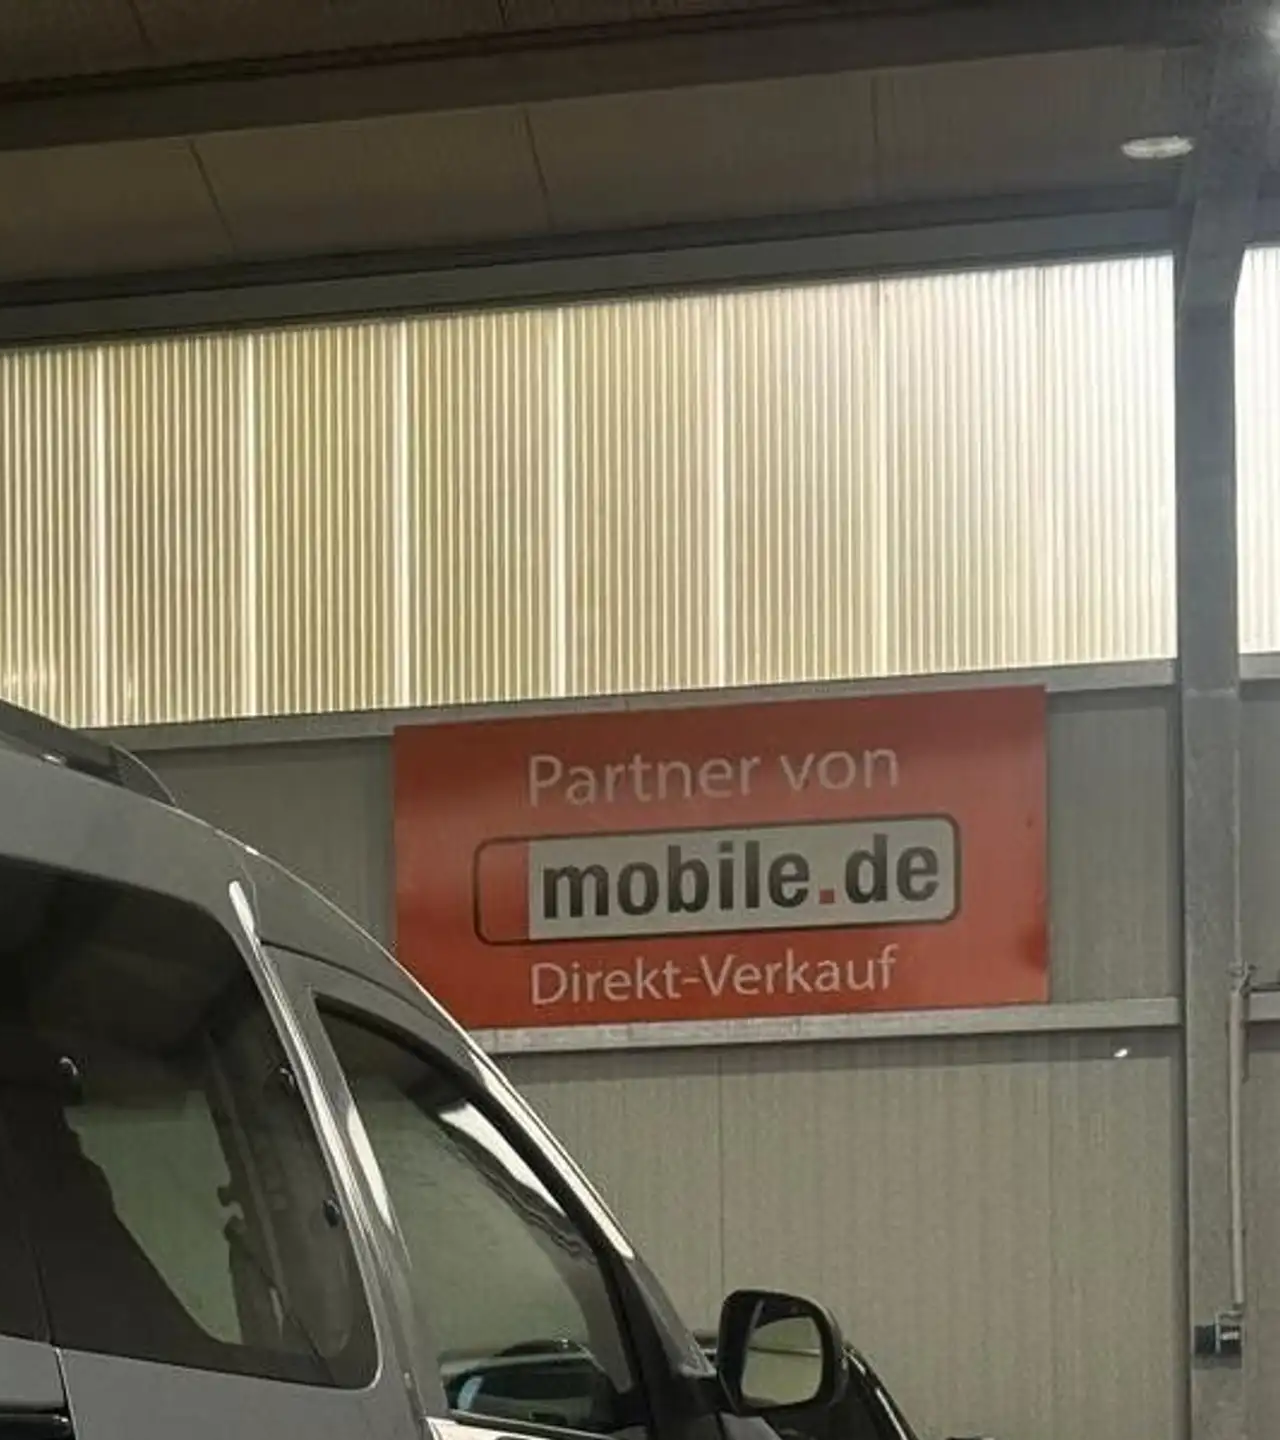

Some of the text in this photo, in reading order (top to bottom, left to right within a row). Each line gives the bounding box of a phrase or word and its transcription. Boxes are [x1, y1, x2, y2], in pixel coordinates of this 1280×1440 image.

[528, 747, 901, 808] Partner von
[541, 833, 940, 920] mobile.de
[530, 944, 900, 1006] Direkt-Verkauf
